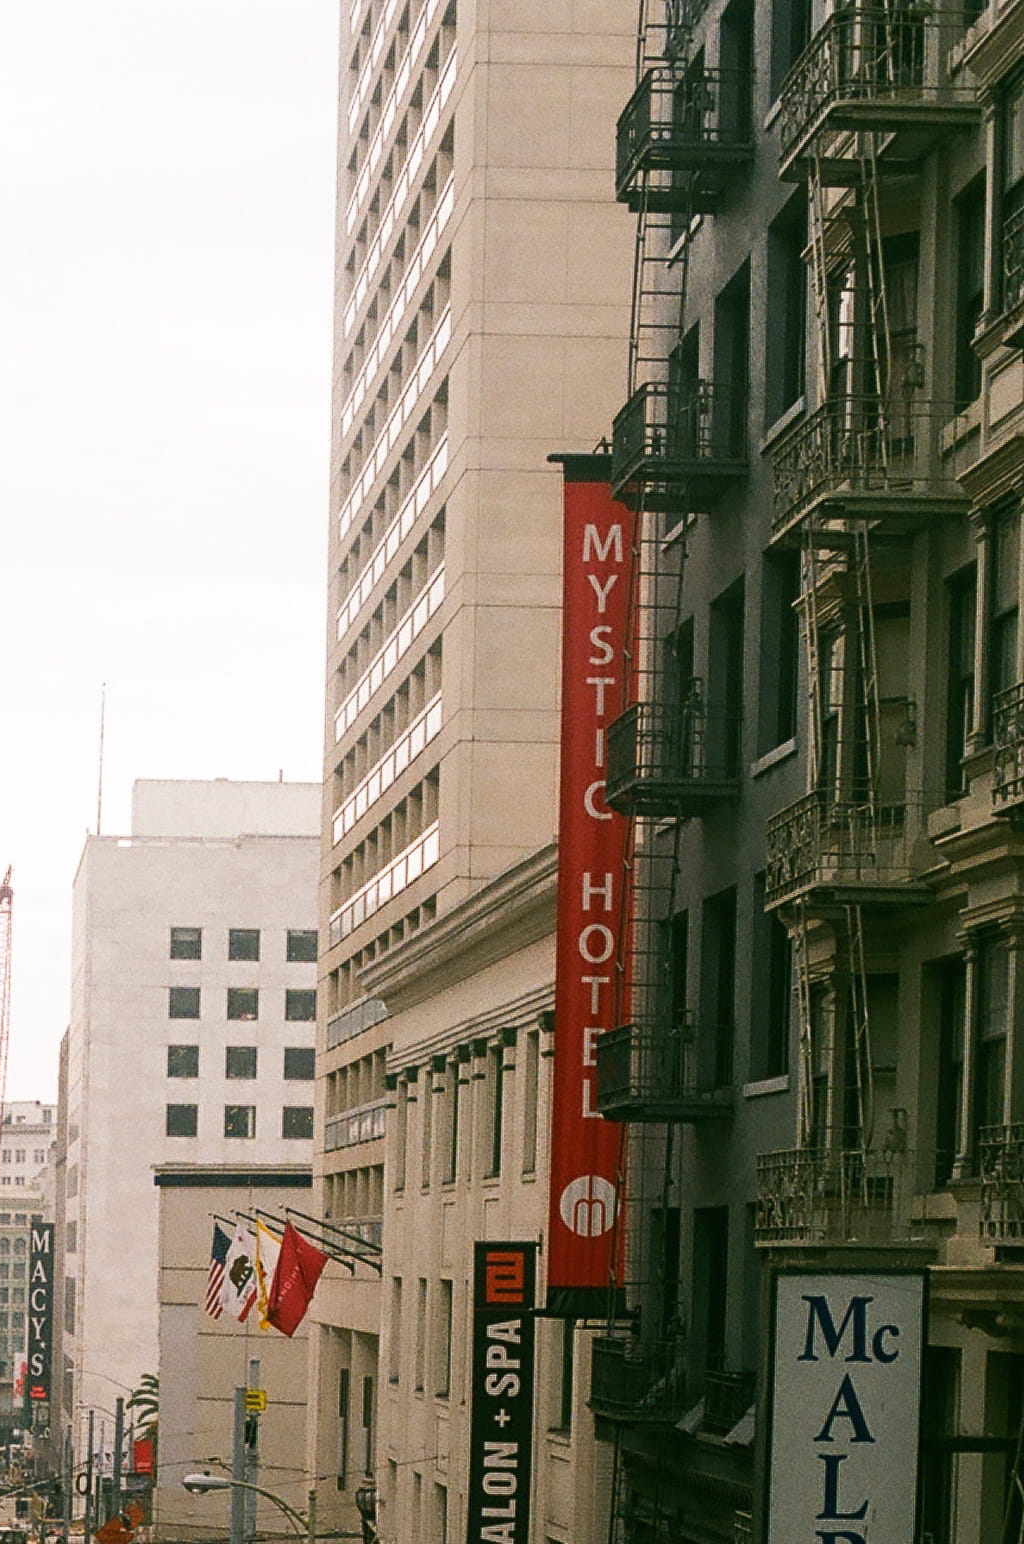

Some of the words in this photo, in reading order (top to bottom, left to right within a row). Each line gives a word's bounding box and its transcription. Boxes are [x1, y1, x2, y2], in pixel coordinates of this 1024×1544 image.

[582, 524, 623, 819] MYSTIC
[578, 872, 614, 1119] HOTEL
[486, 1318, 522, 1397] SPA
